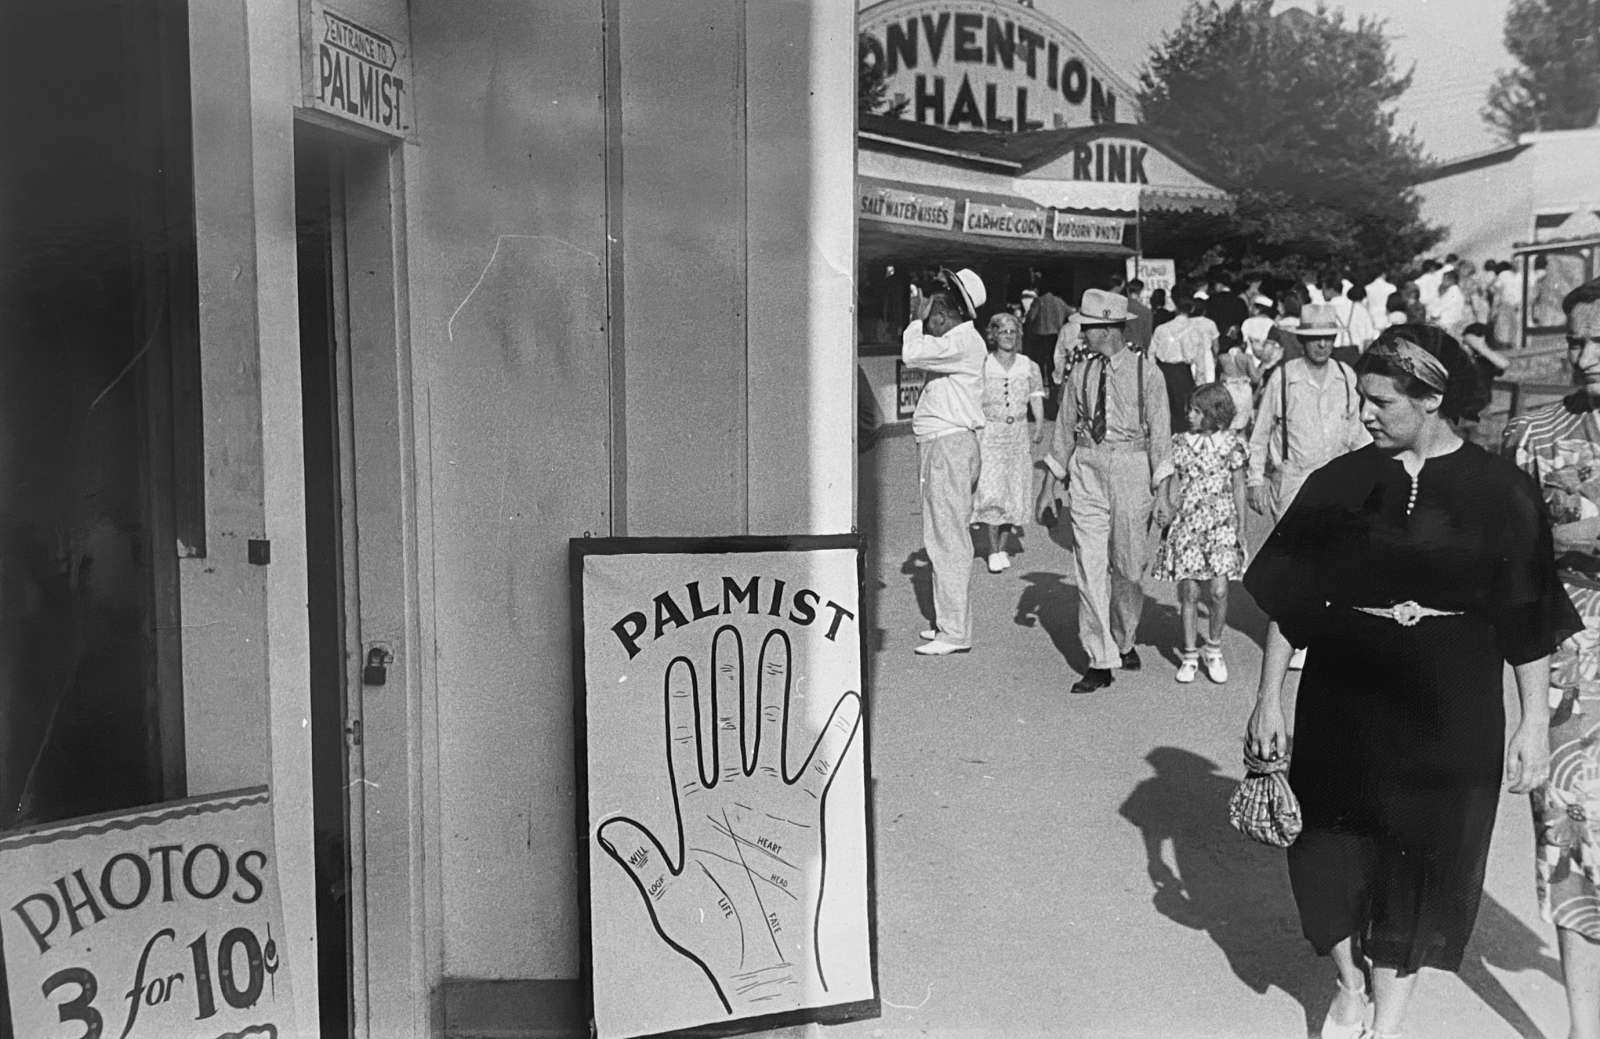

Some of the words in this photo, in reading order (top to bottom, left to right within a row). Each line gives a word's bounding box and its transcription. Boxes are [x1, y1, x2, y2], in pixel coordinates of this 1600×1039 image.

[330, 20, 375, 60] ENTRANCE
[376, 42, 388, 65] TO
[320, 43, 404, 131] PALMIST
[915, 72, 1043, 133] HALL
[1073, 141, 1149, 185] RINK
[861, 195, 886, 215] SALT
[886, 199, 918, 220] WATER
[968, 212, 1013, 232] CARMEL
[1014, 217, 1042, 236] CORN
[611, 576, 855, 660] PALMIST
[628, 845, 648, 867] WILL
[757, 836, 782, 855] HEART
[770, 873, 789, 888] HEAD
[11, 842, 268, 955] PHOTOS
[717, 898, 734, 920] LIFE
[768, 912, 783, 934] FATE
[41, 966, 104, 1039] 3
[119, 927, 185, 1039] for
